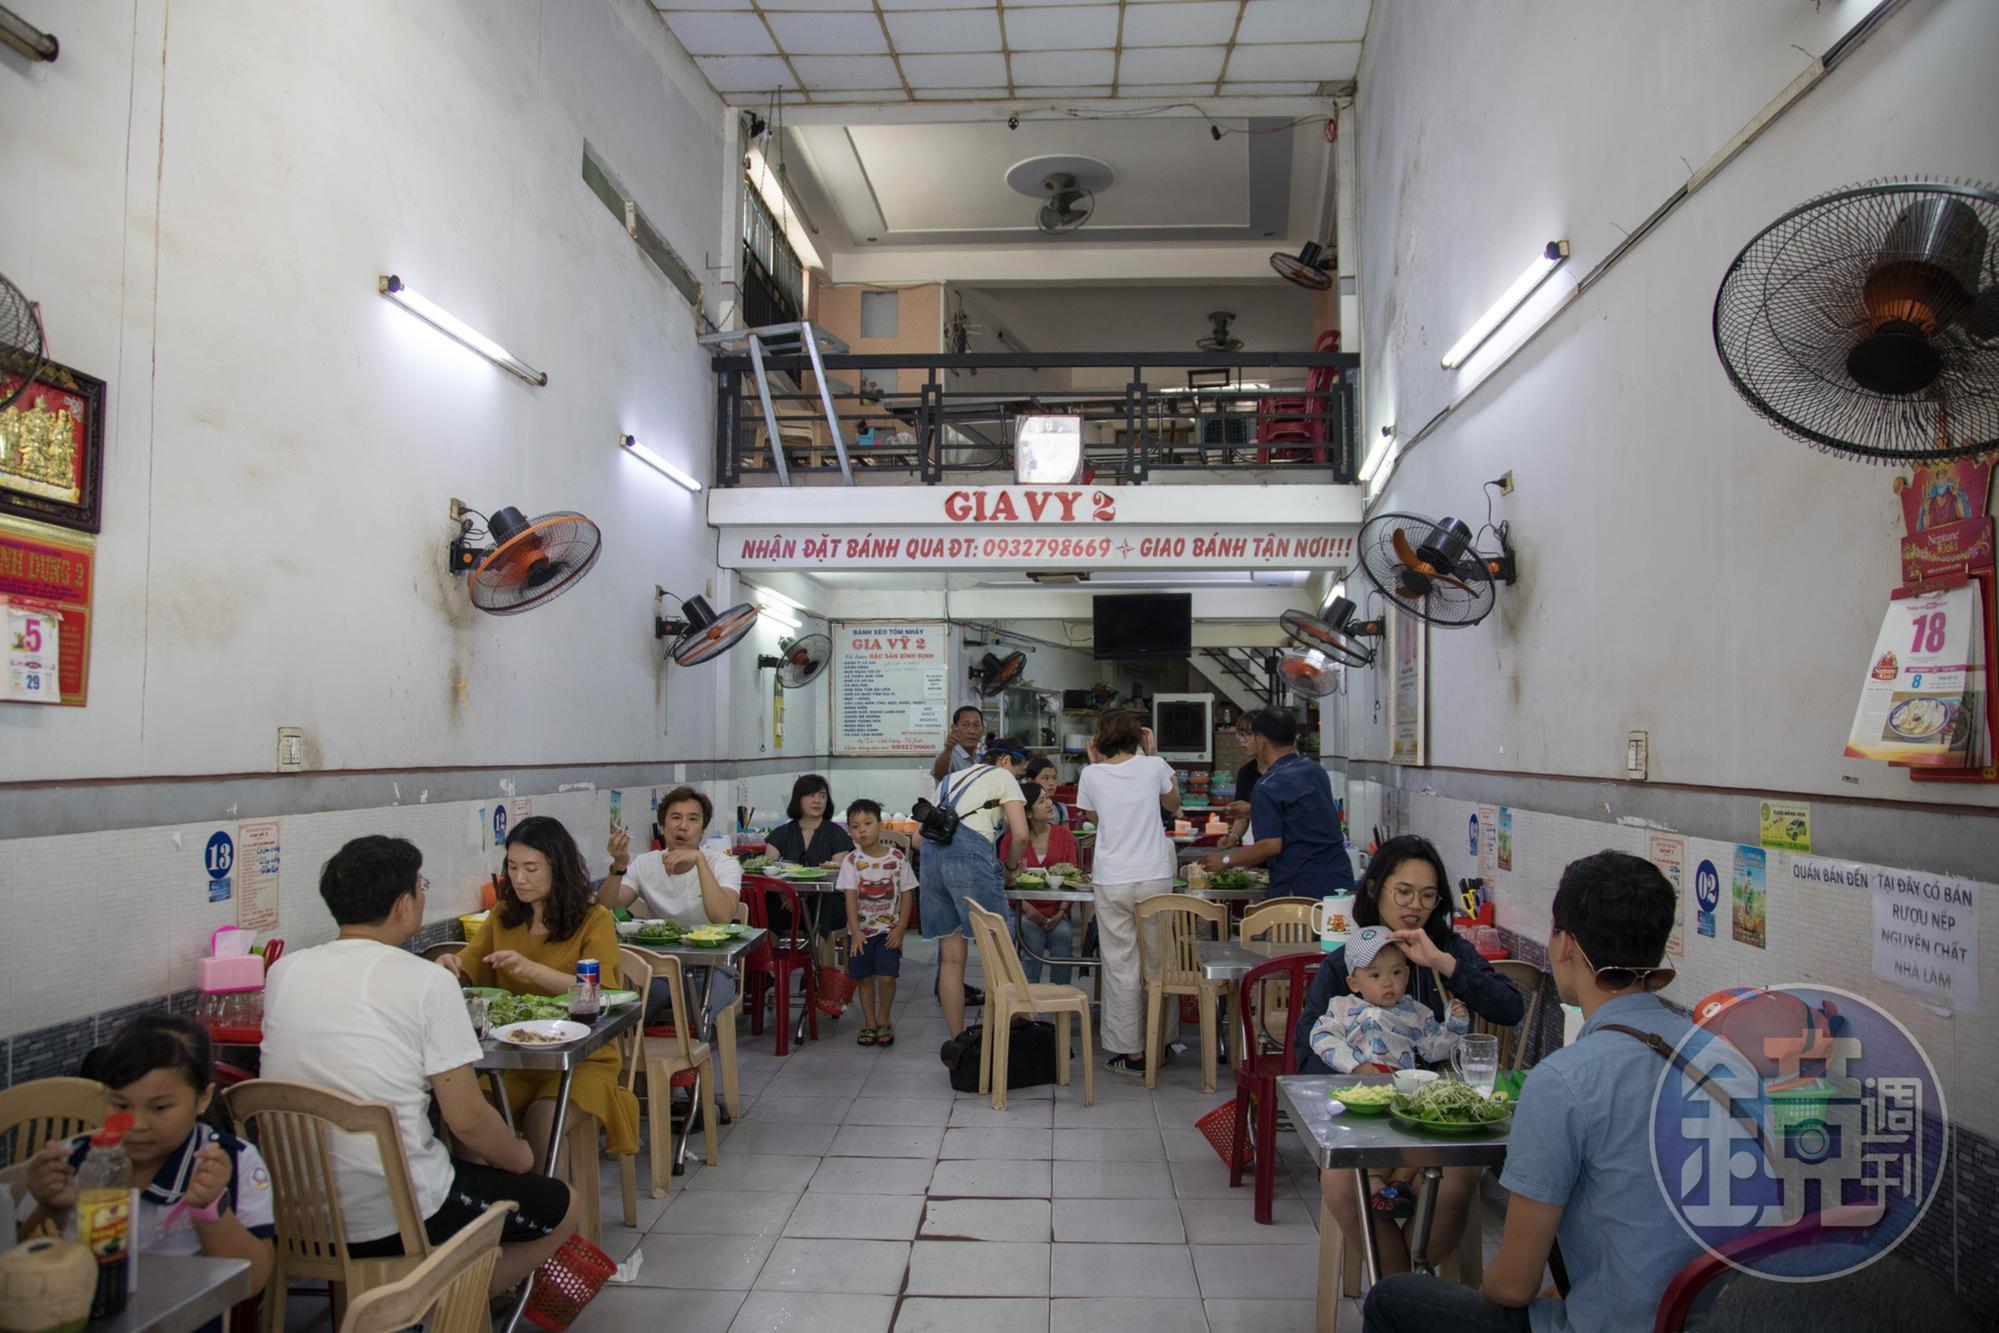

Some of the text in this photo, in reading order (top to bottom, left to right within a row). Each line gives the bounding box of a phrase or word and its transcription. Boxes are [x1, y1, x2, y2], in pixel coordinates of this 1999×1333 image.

[945, 490, 1116, 521] GIA VY 2
[741, 532, 1352, 562] NHẬN ĐẶT BÁNH QUA ĐT: 0932798669 GIAO BÁNH TẬN NƠI!!!
[1928, 531, 1960, 545] Neptune
[25, 618, 42, 652] 5
[852, 639, 882, 650] GIA
[916, 638, 926, 650] 2
[1911, 612, 1946, 653] 18
[26, 674, 41, 689] 29
[1911, 674, 1922, 689] 8
[208, 843, 231, 871] 13
[1699, 871, 1717, 904] 02
[1793, 862, 1869, 888] QUÁN BÁN ĐẾN
[1878, 873, 1973, 907] TẠI ĐÂY CÓ BÁN
[1892, 903, 1956, 931] RƯỢU NẾP
[1881, 928, 1968, 962] NGUYÊN CHẤT
[1894, 959, 1951, 988] NHÀ LÀM
